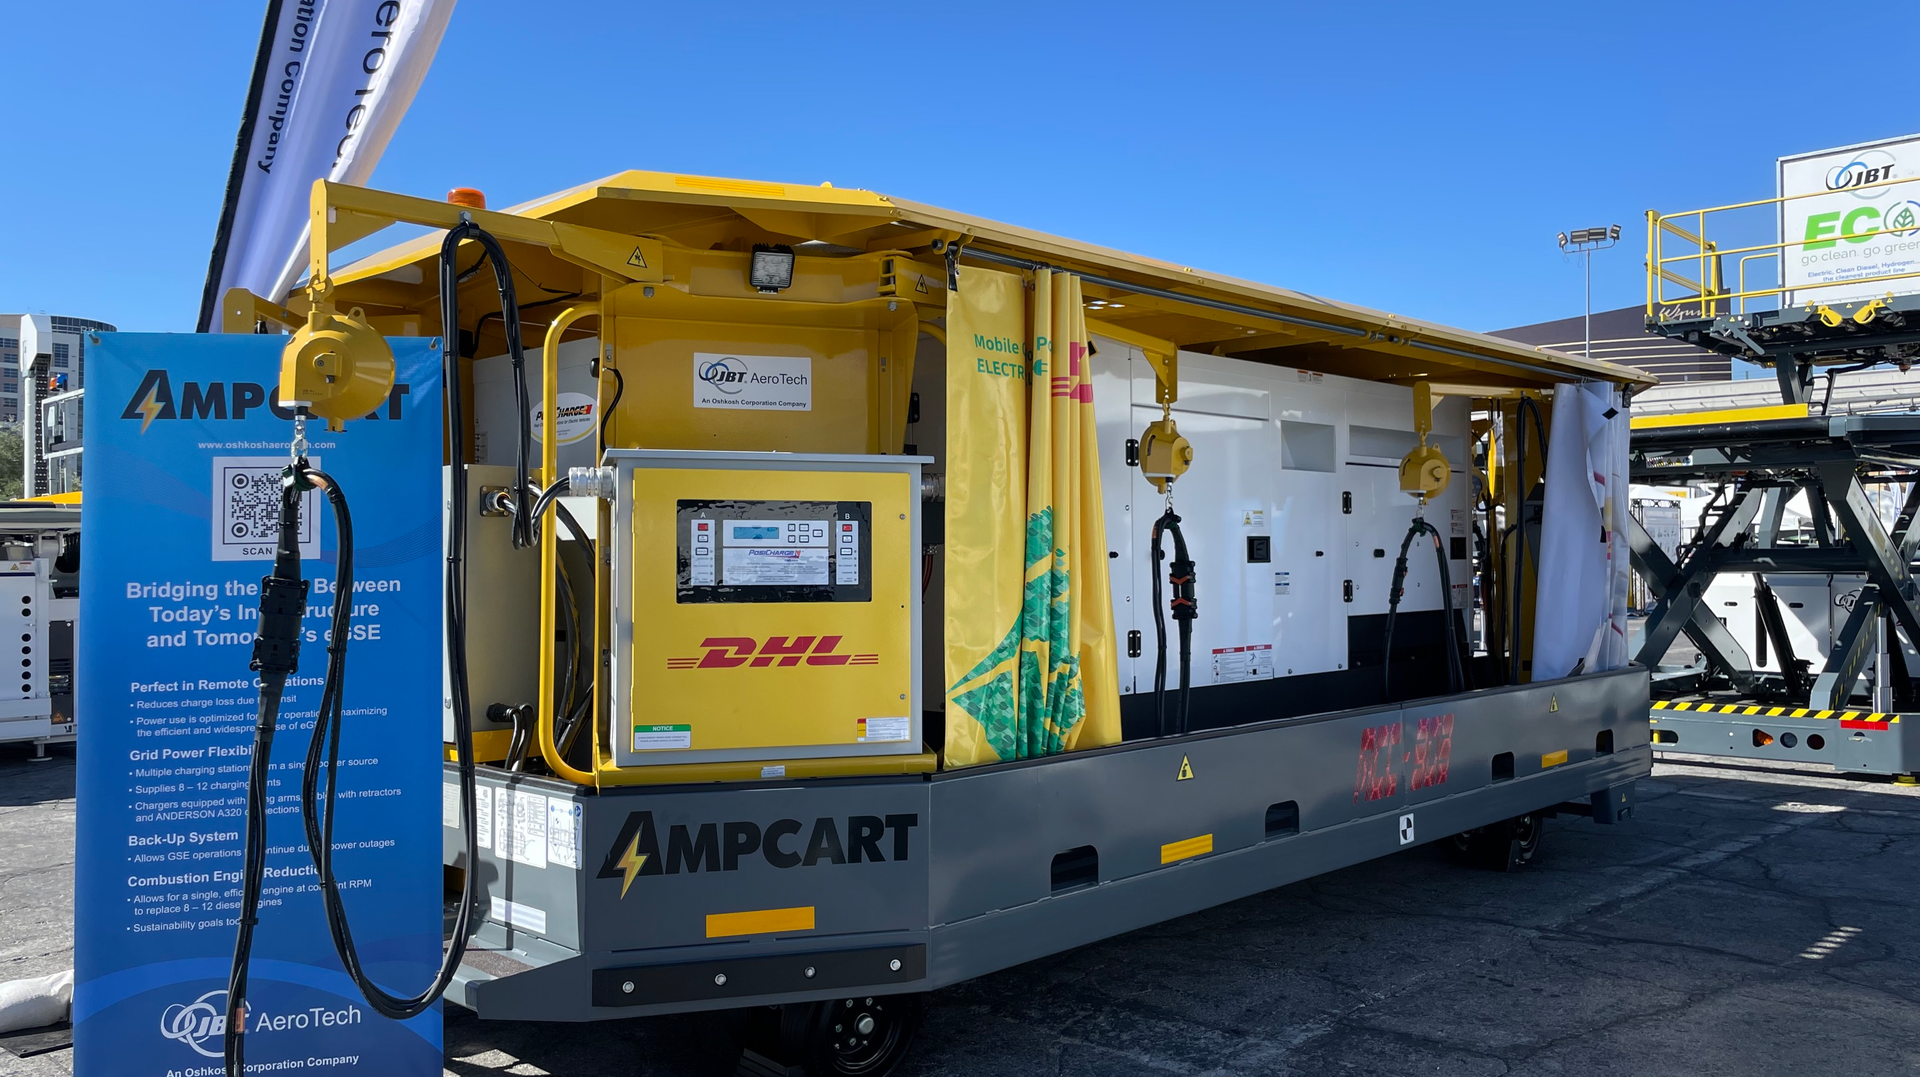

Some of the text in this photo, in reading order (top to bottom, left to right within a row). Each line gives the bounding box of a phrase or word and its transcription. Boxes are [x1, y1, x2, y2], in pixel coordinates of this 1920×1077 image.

[258, 61, 301, 174] Company
[1851, 164, 1895, 188] JBT
[1801, 253, 1818, 266] go
[1821, 249, 1860, 262] clean.
[1863, 246, 1881, 259] go
[1865, 269, 1892, 279] product
[1893, 266, 1905, 274] line
[974, 334, 1019, 354] Mobile
[716, 371, 808, 385] JBT AeroTech
[120, 369, 410, 421] AMPT
[741, 399, 777, 407] Corporation
[778, 400, 807, 408] Company
[198, 440, 336, 450] www.oshkoshaeroh.com
[242, 547, 273, 556] SCAN
[126, 579, 401, 602] Bridging the Beween
[238, 603, 380, 621] Inrucure
[146, 631, 187, 648] and
[193, 626, 318, 646] Tomor’s
[697, 635, 852, 669] DHL
[131, 676, 324, 693] Perfect in Remote Oations
[136, 700, 179, 709] Reduces
[181, 698, 213, 708] charge
[216, 698, 234, 706] loss
[237, 697, 255, 705] due
[136, 716, 167, 726] Power
[169, 717, 187, 725] use
[189, 715, 197, 723] is
[199, 712, 244, 723] optimized
[246, 712, 258, 720] for
[137, 729, 152, 737] the
[155, 727, 191, 736] efficient
[194, 726, 211, 735] and
[214, 725, 256, 734] widespre
[289, 722, 298, 730] of
[129, 745, 255, 760] Grid Power Flexibi
[136, 768, 172, 778] Multiple
[175, 766, 215, 776] charging
[288, 760, 306, 771] sing
[348, 757, 379, 766] source
[135, 785, 176, 795] Supplies
[178, 783, 185, 792] 8
[197, 782, 208, 791] 12
[135, 800, 178, 811] Chargers
[181, 797, 224, 809] equipped
[227, 796, 246, 806] with
[338, 789, 356, 799] with
[359, 788, 401, 799] retractors
[136, 814, 154, 822] and
[155, 810, 215, 821] ANDERSON
[217, 808, 242, 818] A320
[128, 831, 239, 847] Back-Up System
[596, 811, 918, 879] AMPCART
[134, 854, 165, 863] Allows
[168, 851, 190, 861] GSE
[193, 848, 242, 860] operations
[265, 844, 295, 854] ntinue
[359, 839, 396, 850] outages
[128, 864, 319, 887] Combustion Engi Reducti
[134, 895, 165, 904] Allows
[167, 893, 180, 901] for
[182, 893, 188, 901] a
[191, 890, 222, 901] single,
[263, 884, 294, 895] engine
[296, 884, 306, 892] at
[350, 878, 372, 889] RPM
[134, 907, 143, 916] to
[146, 904, 181, 916] replace
[183, 903, 190, 912] 8
[202, 901, 213, 911] 12
[133, 919, 196, 932] Sustainability
[198, 918, 224, 929] goals
[255, 1004, 361, 1033] AeroTech
[184, 1067, 227, 1077] Oshkos
[307, 1054, 360, 1068] Company
